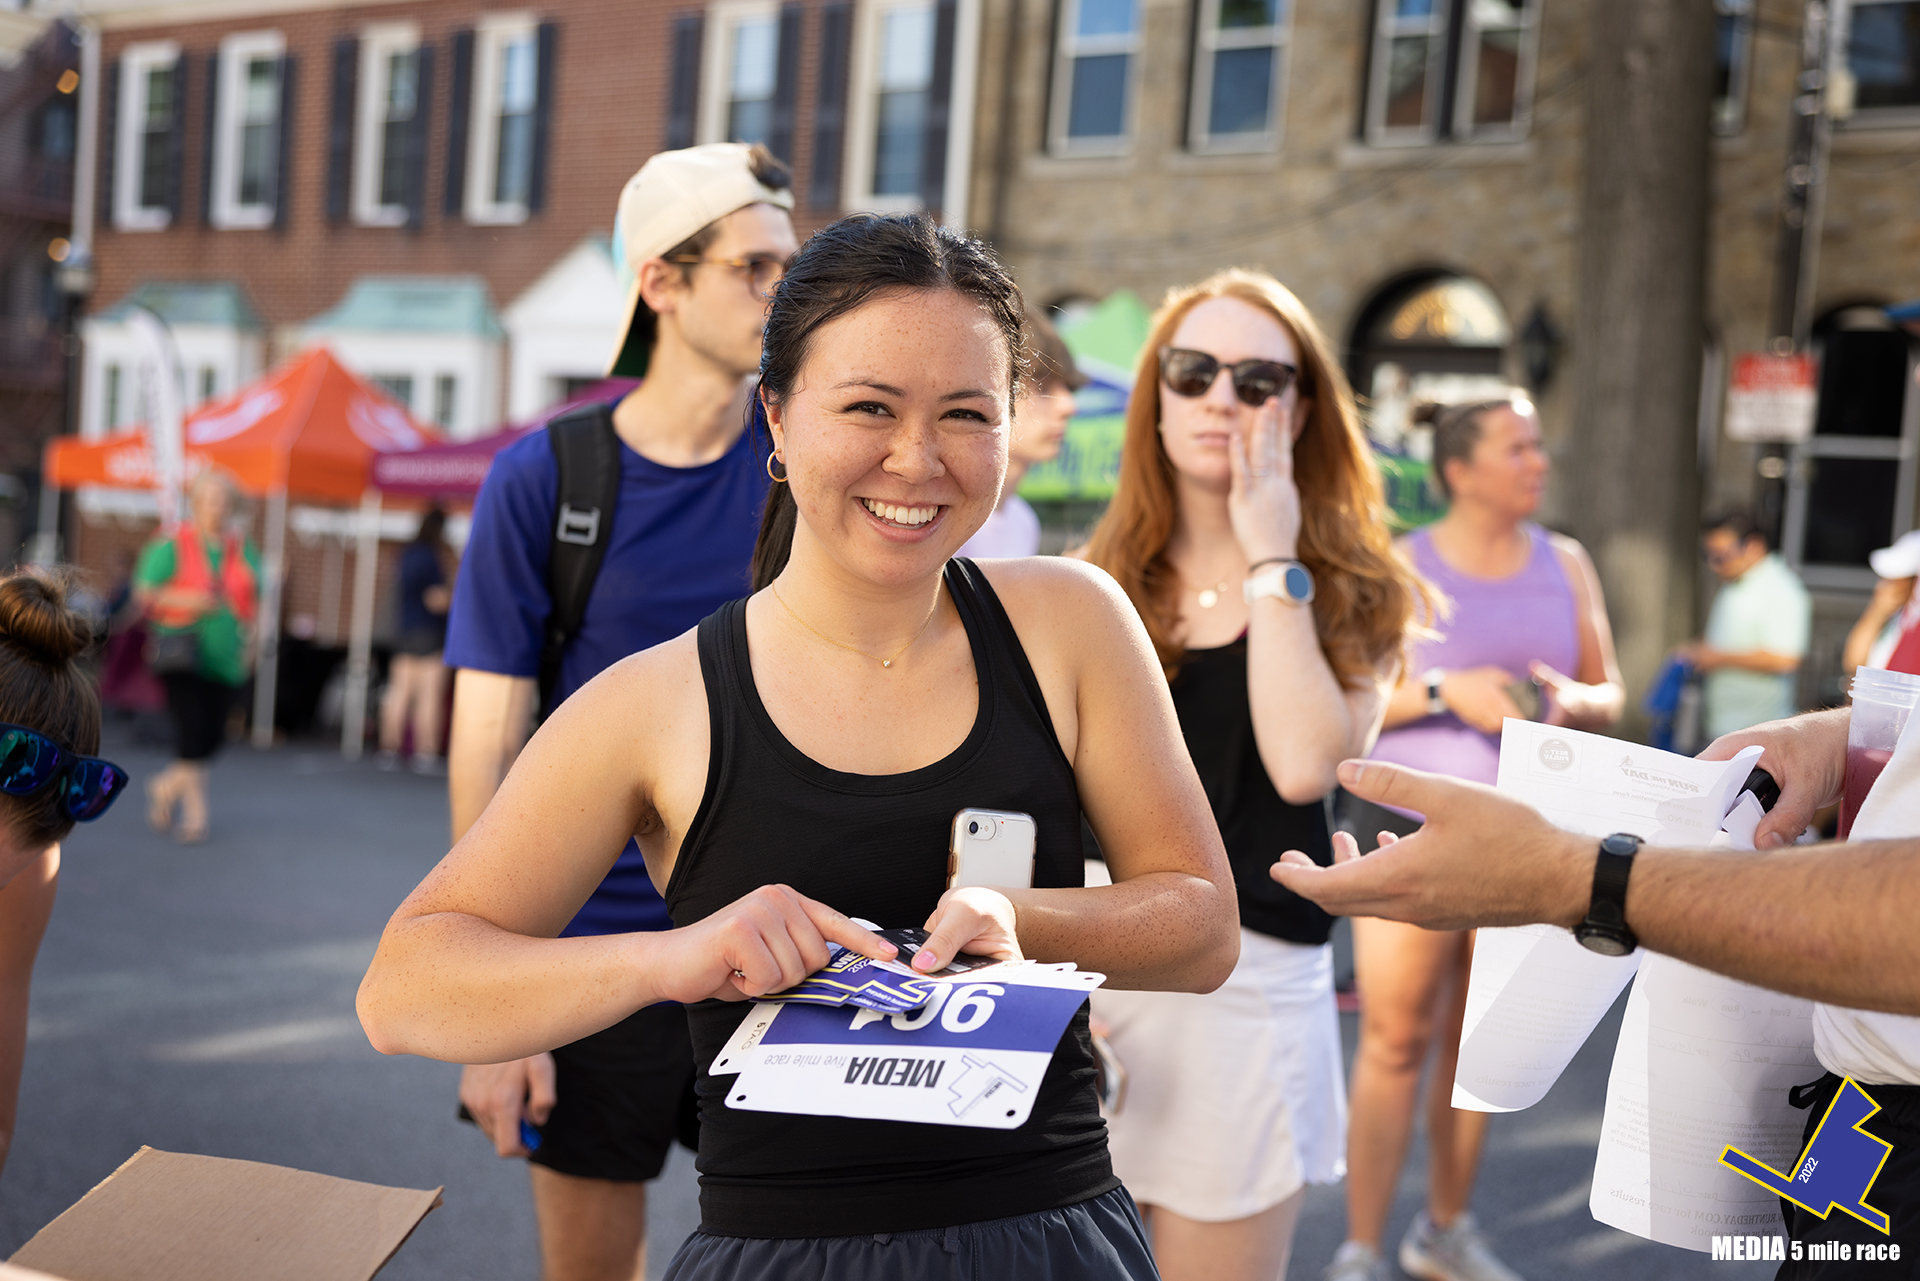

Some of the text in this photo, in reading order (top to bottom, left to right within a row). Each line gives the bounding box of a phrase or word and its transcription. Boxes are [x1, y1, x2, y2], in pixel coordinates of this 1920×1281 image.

[763, 1054, 946, 1088] MEDIA five mile race
